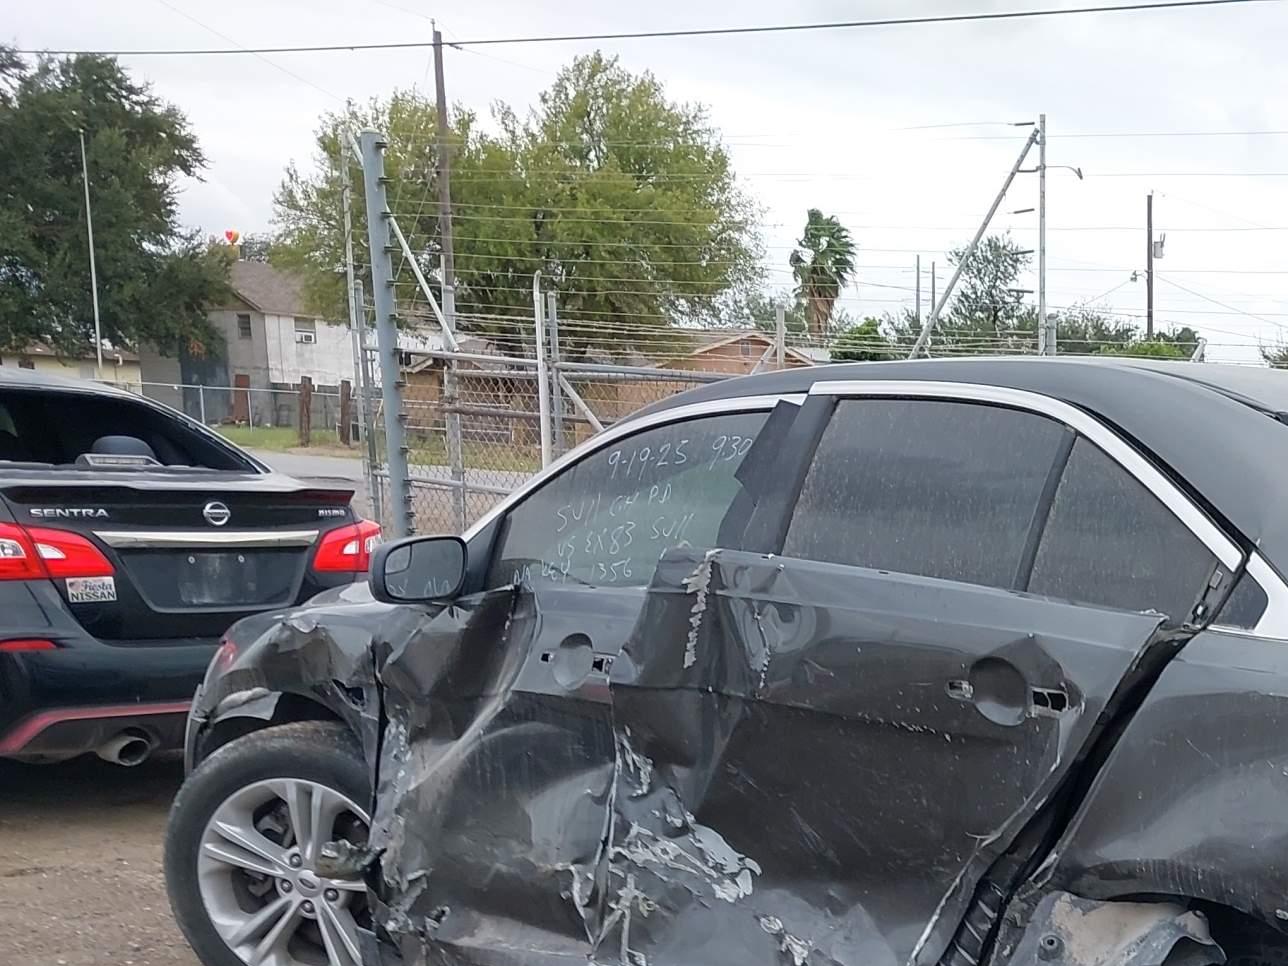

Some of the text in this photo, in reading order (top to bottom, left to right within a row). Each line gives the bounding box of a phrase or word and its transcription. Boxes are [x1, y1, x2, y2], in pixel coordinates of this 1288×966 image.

[608, 440, 689, 480] 9-19-25
[30, 508, 110, 518] SENTRA
[81, 580, 113, 591] Fiesta
[71, 590, 116, 601] NISSAN
